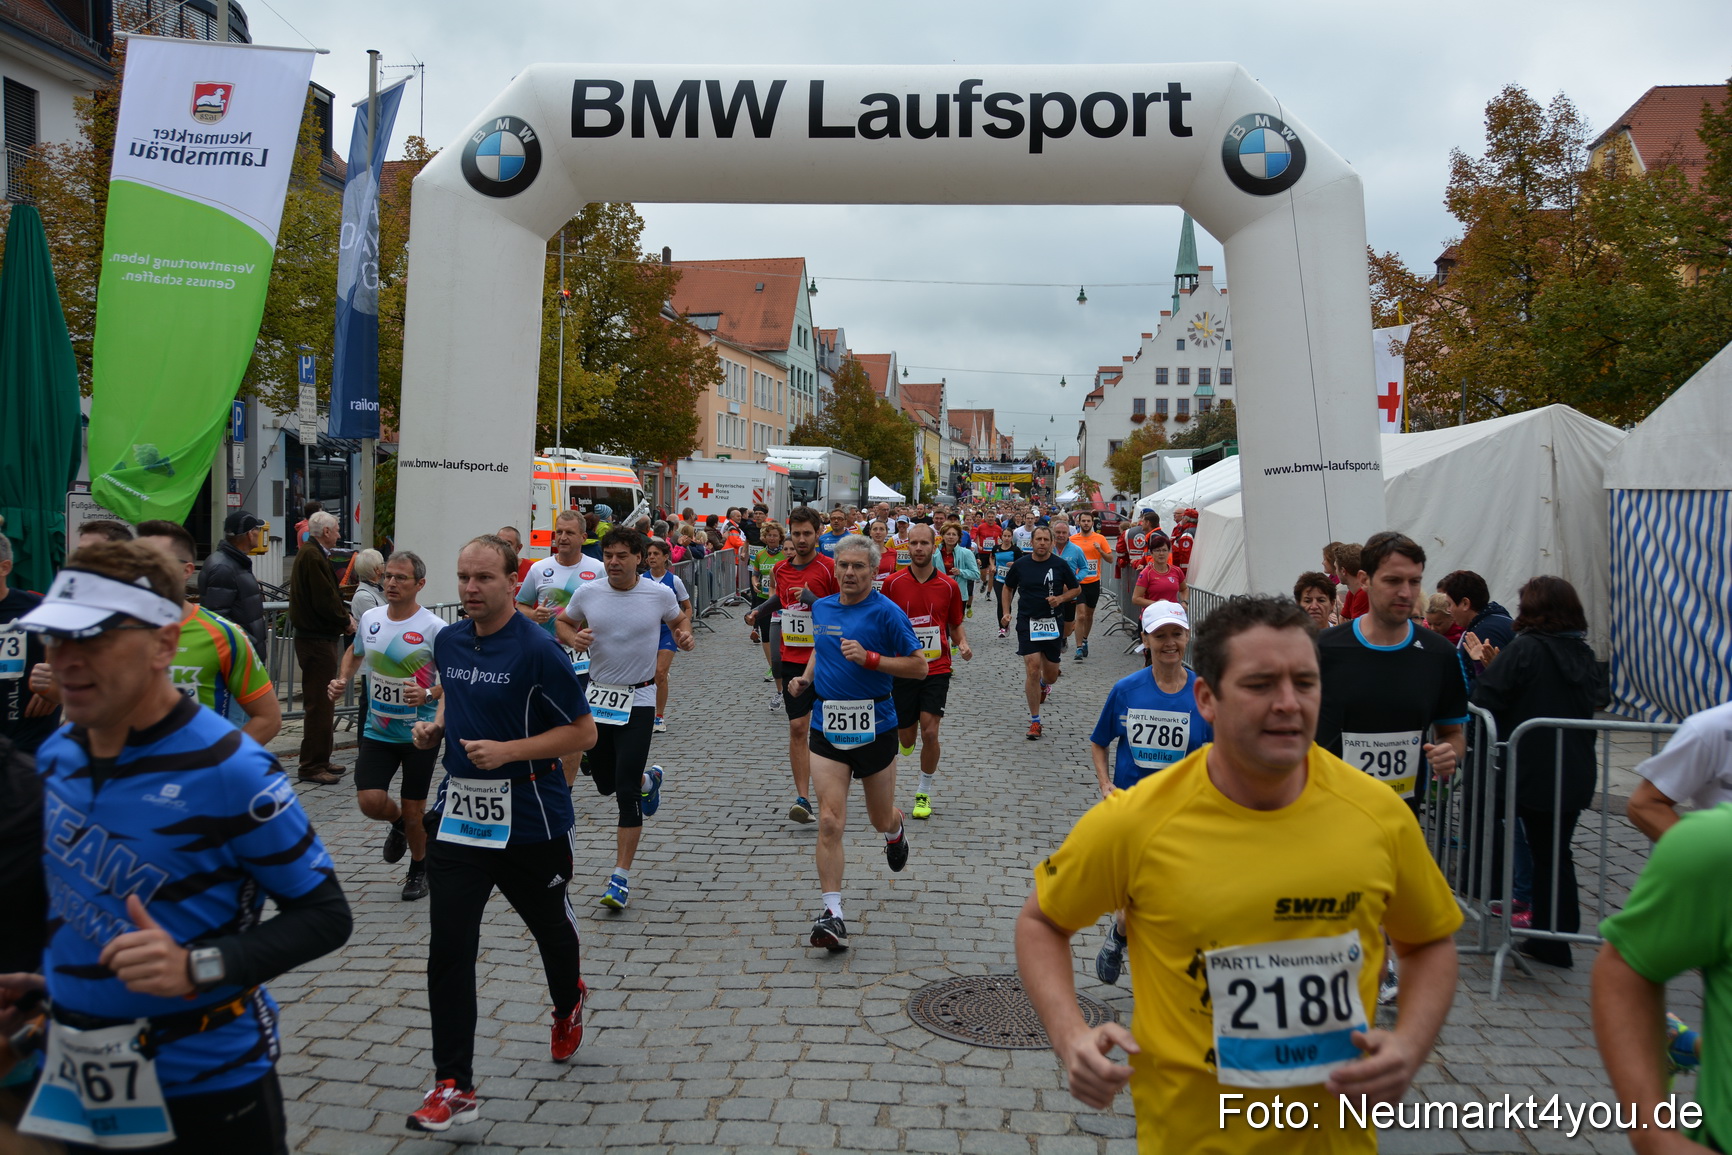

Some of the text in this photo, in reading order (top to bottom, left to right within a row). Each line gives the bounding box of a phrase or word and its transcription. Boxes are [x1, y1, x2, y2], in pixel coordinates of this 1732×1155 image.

[571, 79, 1193, 154] BMW Laufsport
[472, 117, 537, 144] BMW
[1229, 114, 1297, 142] BMW
[235, 406, 243, 437] P
[1263, 459, 1380, 476] www.bmw-laufsport.de
[789, 619, 805, 633] 15
[374, 683, 400, 703] 281
[588, 689, 630, 709] 2797
[596, 709, 614, 718] Peter
[827, 712, 870, 731] 2518
[1128, 713, 1180, 723] PARTL Neumarkt
[834, 735, 862, 743] Michael
[1132, 722, 1184, 748] 2786
[1344, 739, 1410, 747] PARTL Neumarkt
[1138, 749, 1173, 761] Angelika
[1360, 749, 1407, 777] 298
[463, 785, 497, 793] Neumarkt
[451, 791, 505, 821] 2155
[460, 823, 493, 837] Marcus
[1210, 952, 1345, 970] PARTL Neumarkt
[1227, 969, 1353, 1030] 2180
[1274, 1043, 1319, 1065] Uwe
